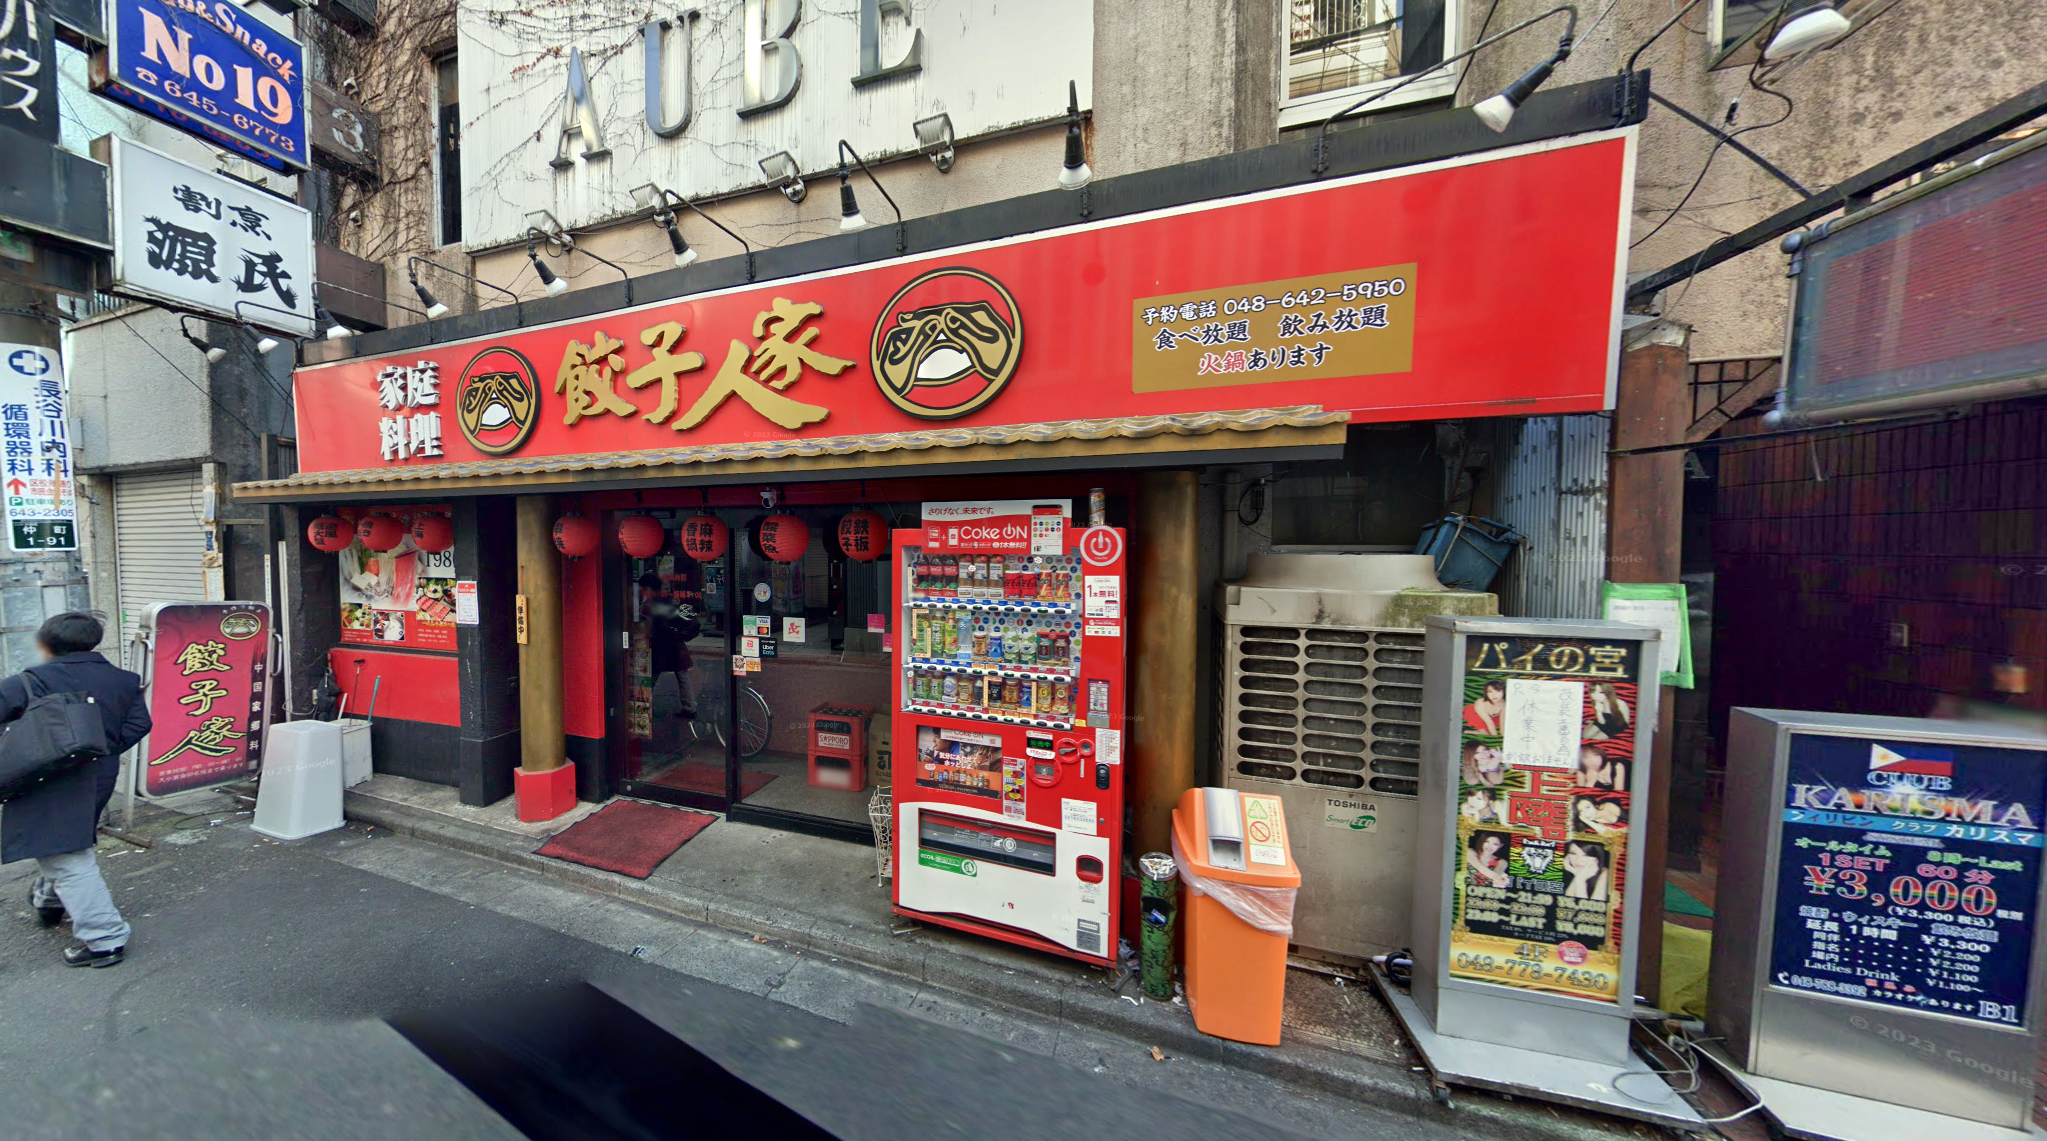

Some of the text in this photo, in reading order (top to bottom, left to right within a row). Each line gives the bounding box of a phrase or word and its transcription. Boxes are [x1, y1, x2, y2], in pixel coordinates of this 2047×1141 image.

[139, 6, 225, 91] No
[233, 64, 293, 125] 19
[164, 80, 295, 152] 645-6773
[172, 184, 272, 241] 割烹
[142, 214, 299, 310] 源氏
[1141, 277, 1406, 326] 予約電話 048-642-5950
[1153, 303, 1390, 351] 食べ放題 飲み放題
[1197, 341, 1333, 376] 火鍋あります
[376, 359, 441, 411] 家庭
[2, 403, 34, 477] 循環器科
[35, 380, 69, 478] 長谷川内科
[380, 411, 444, 462] 料理
[10, 509, 74, 517] 643-2305
[26, 537, 65, 545] 1-91
[960, 523, 1028, 539] Coke ON
[425, 550, 454, 568] 198
[1472, 642, 1628, 677] パイの宮
[1867, 771, 1952, 791] CLUB
[1326, 814, 1350, 825] Smart
[1327, 799, 1376, 812] TOSHIBA
[1790, 783, 2039, 830] KARISMA
[1891, 820, 1937, 833] クラブ
[1945, 824, 2035, 846] カリスマ
[1818, 852, 1996, 885] 1SET 60 分
[1803, 865, 1998, 917] ¥3,000
[1806, 919, 1839, 932] 延長
[1514, 943, 1549, 962] 4F
[1804, 959, 1852, 974] Ladies
[1856, 967, 1900, 981] Drink
[1457, 952, 1609, 990] 048-778-7430
[1978, 1000, 2018, 1023] B1
